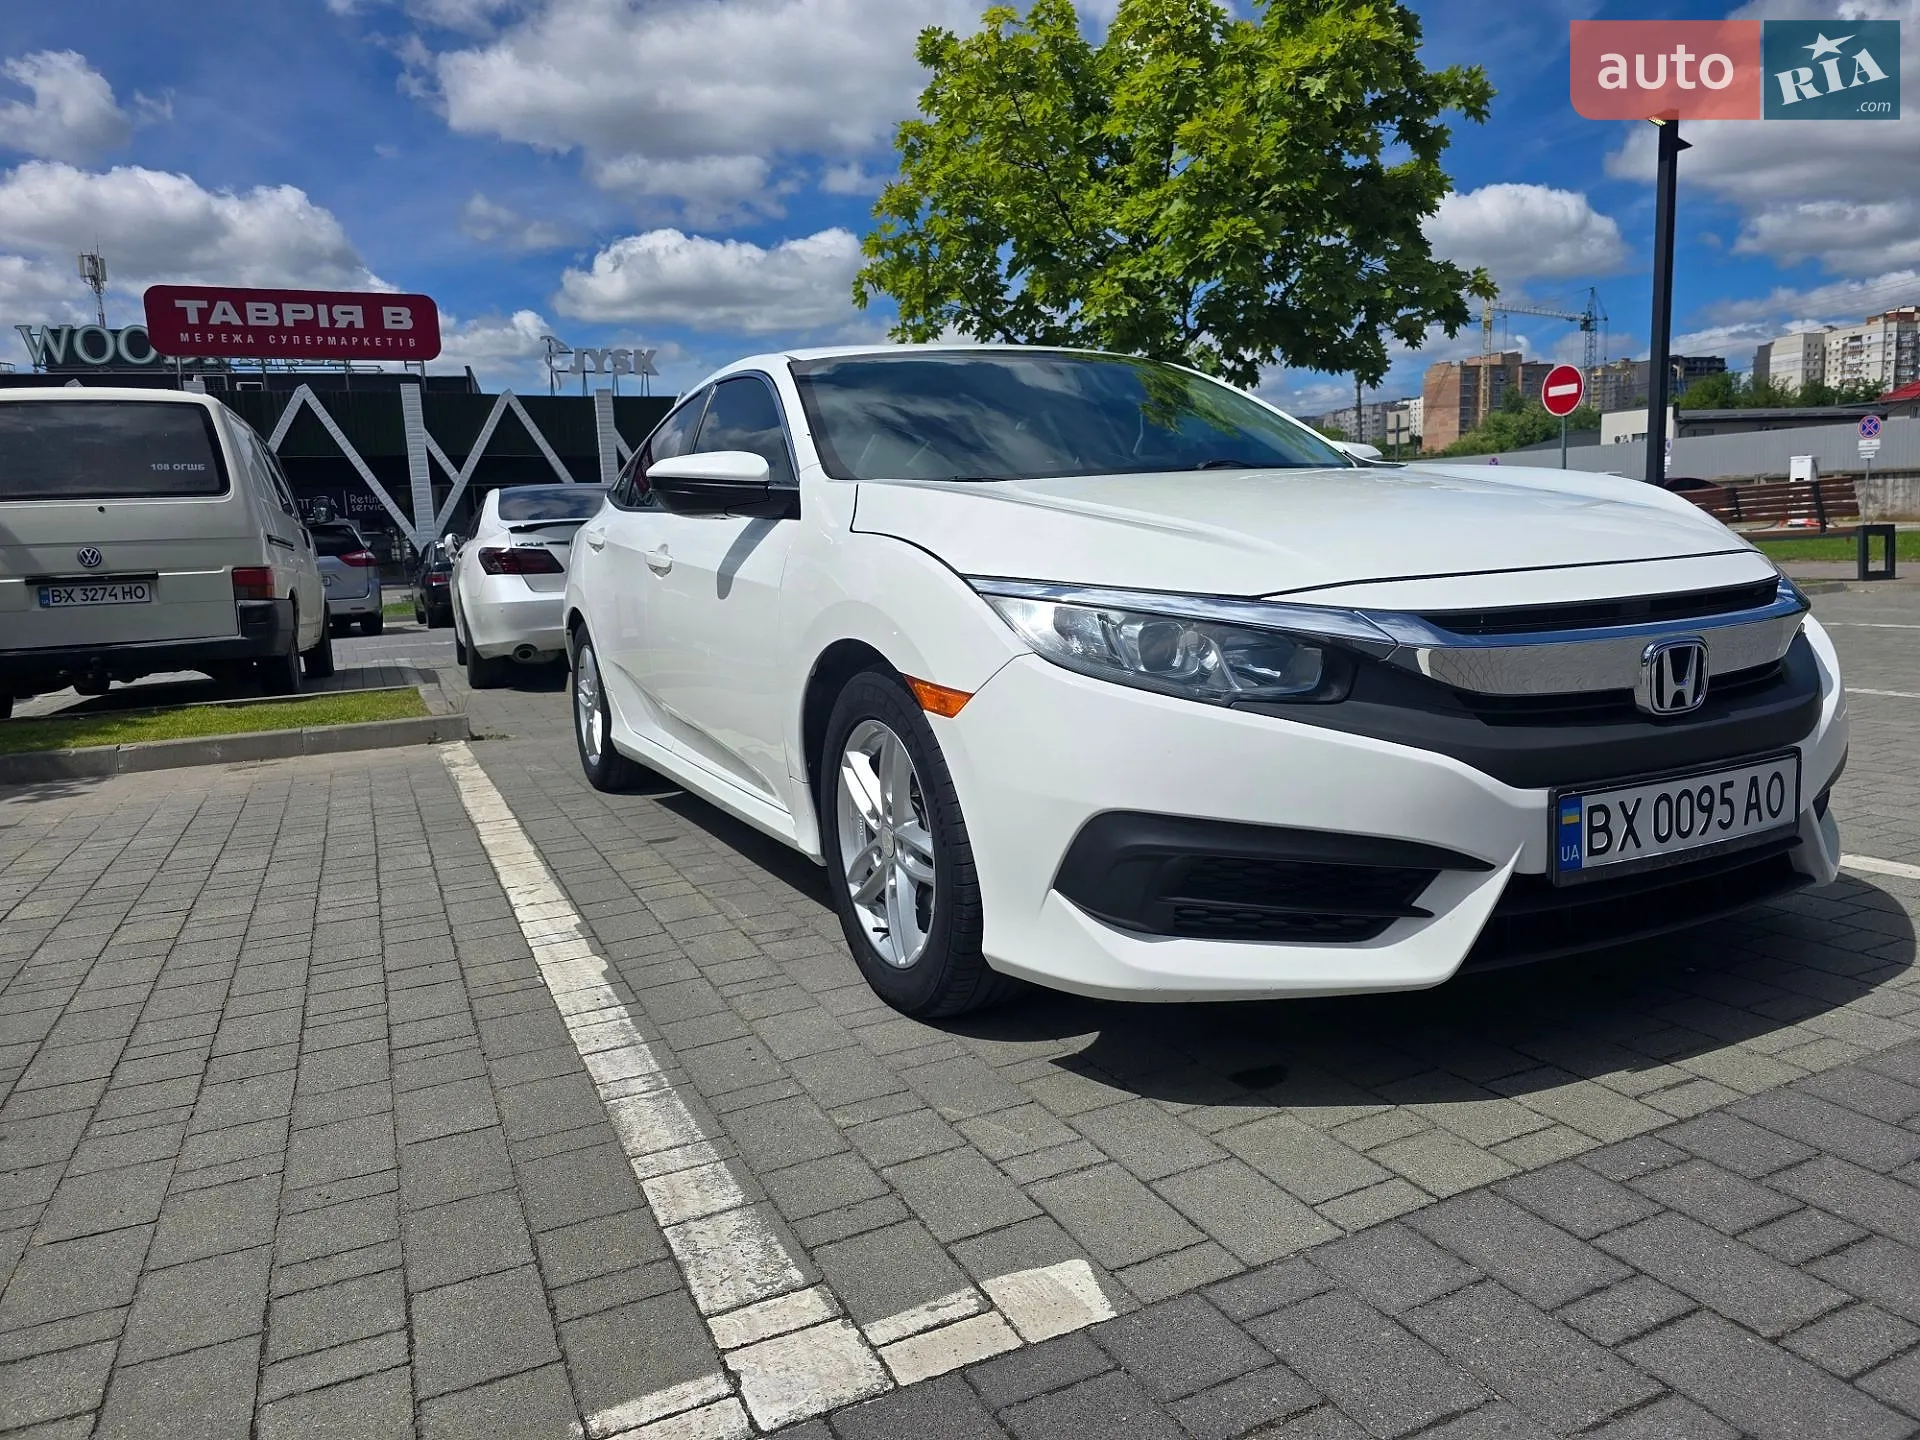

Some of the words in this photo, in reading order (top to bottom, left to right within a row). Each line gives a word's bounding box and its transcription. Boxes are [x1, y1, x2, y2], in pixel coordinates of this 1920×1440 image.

[174, 299, 365, 329] ТАВРІЯ
[382, 306, 414, 330] В
[179, 332, 255, 345] МЕРЕЖА
[268, 334, 417, 348] СУПЕРМАРКЕТІВ
[568, 347, 660, 376] JYSK
[51, 588, 76, 603] BX
[80, 586, 118, 602] 3274
[121, 585, 146, 600] HO
[1586, 797, 1643, 858] BX
[1652, 780, 1736, 844] 0095
[1561, 844, 1580, 863] UA
